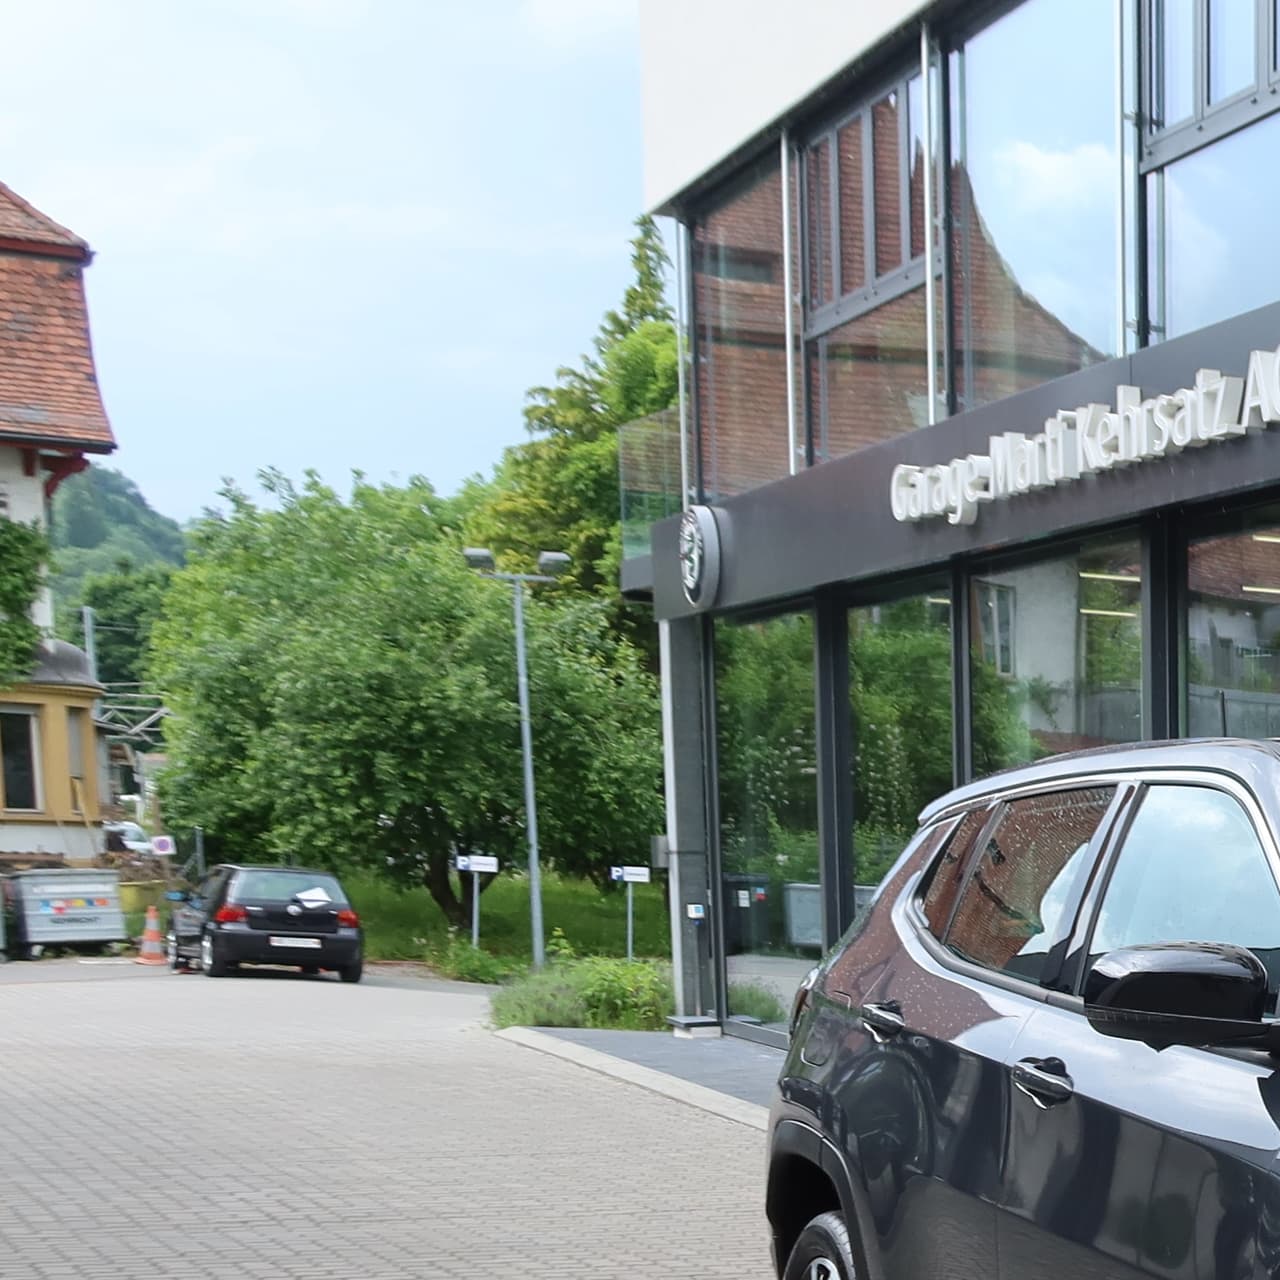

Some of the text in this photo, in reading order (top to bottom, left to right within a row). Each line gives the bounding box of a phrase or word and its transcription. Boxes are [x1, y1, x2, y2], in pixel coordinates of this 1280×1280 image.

[891, 454, 994, 525] Garage
[989, 411, 1080, 499] Marti
[1076, 369, 1246, 472] Kehrsatz
